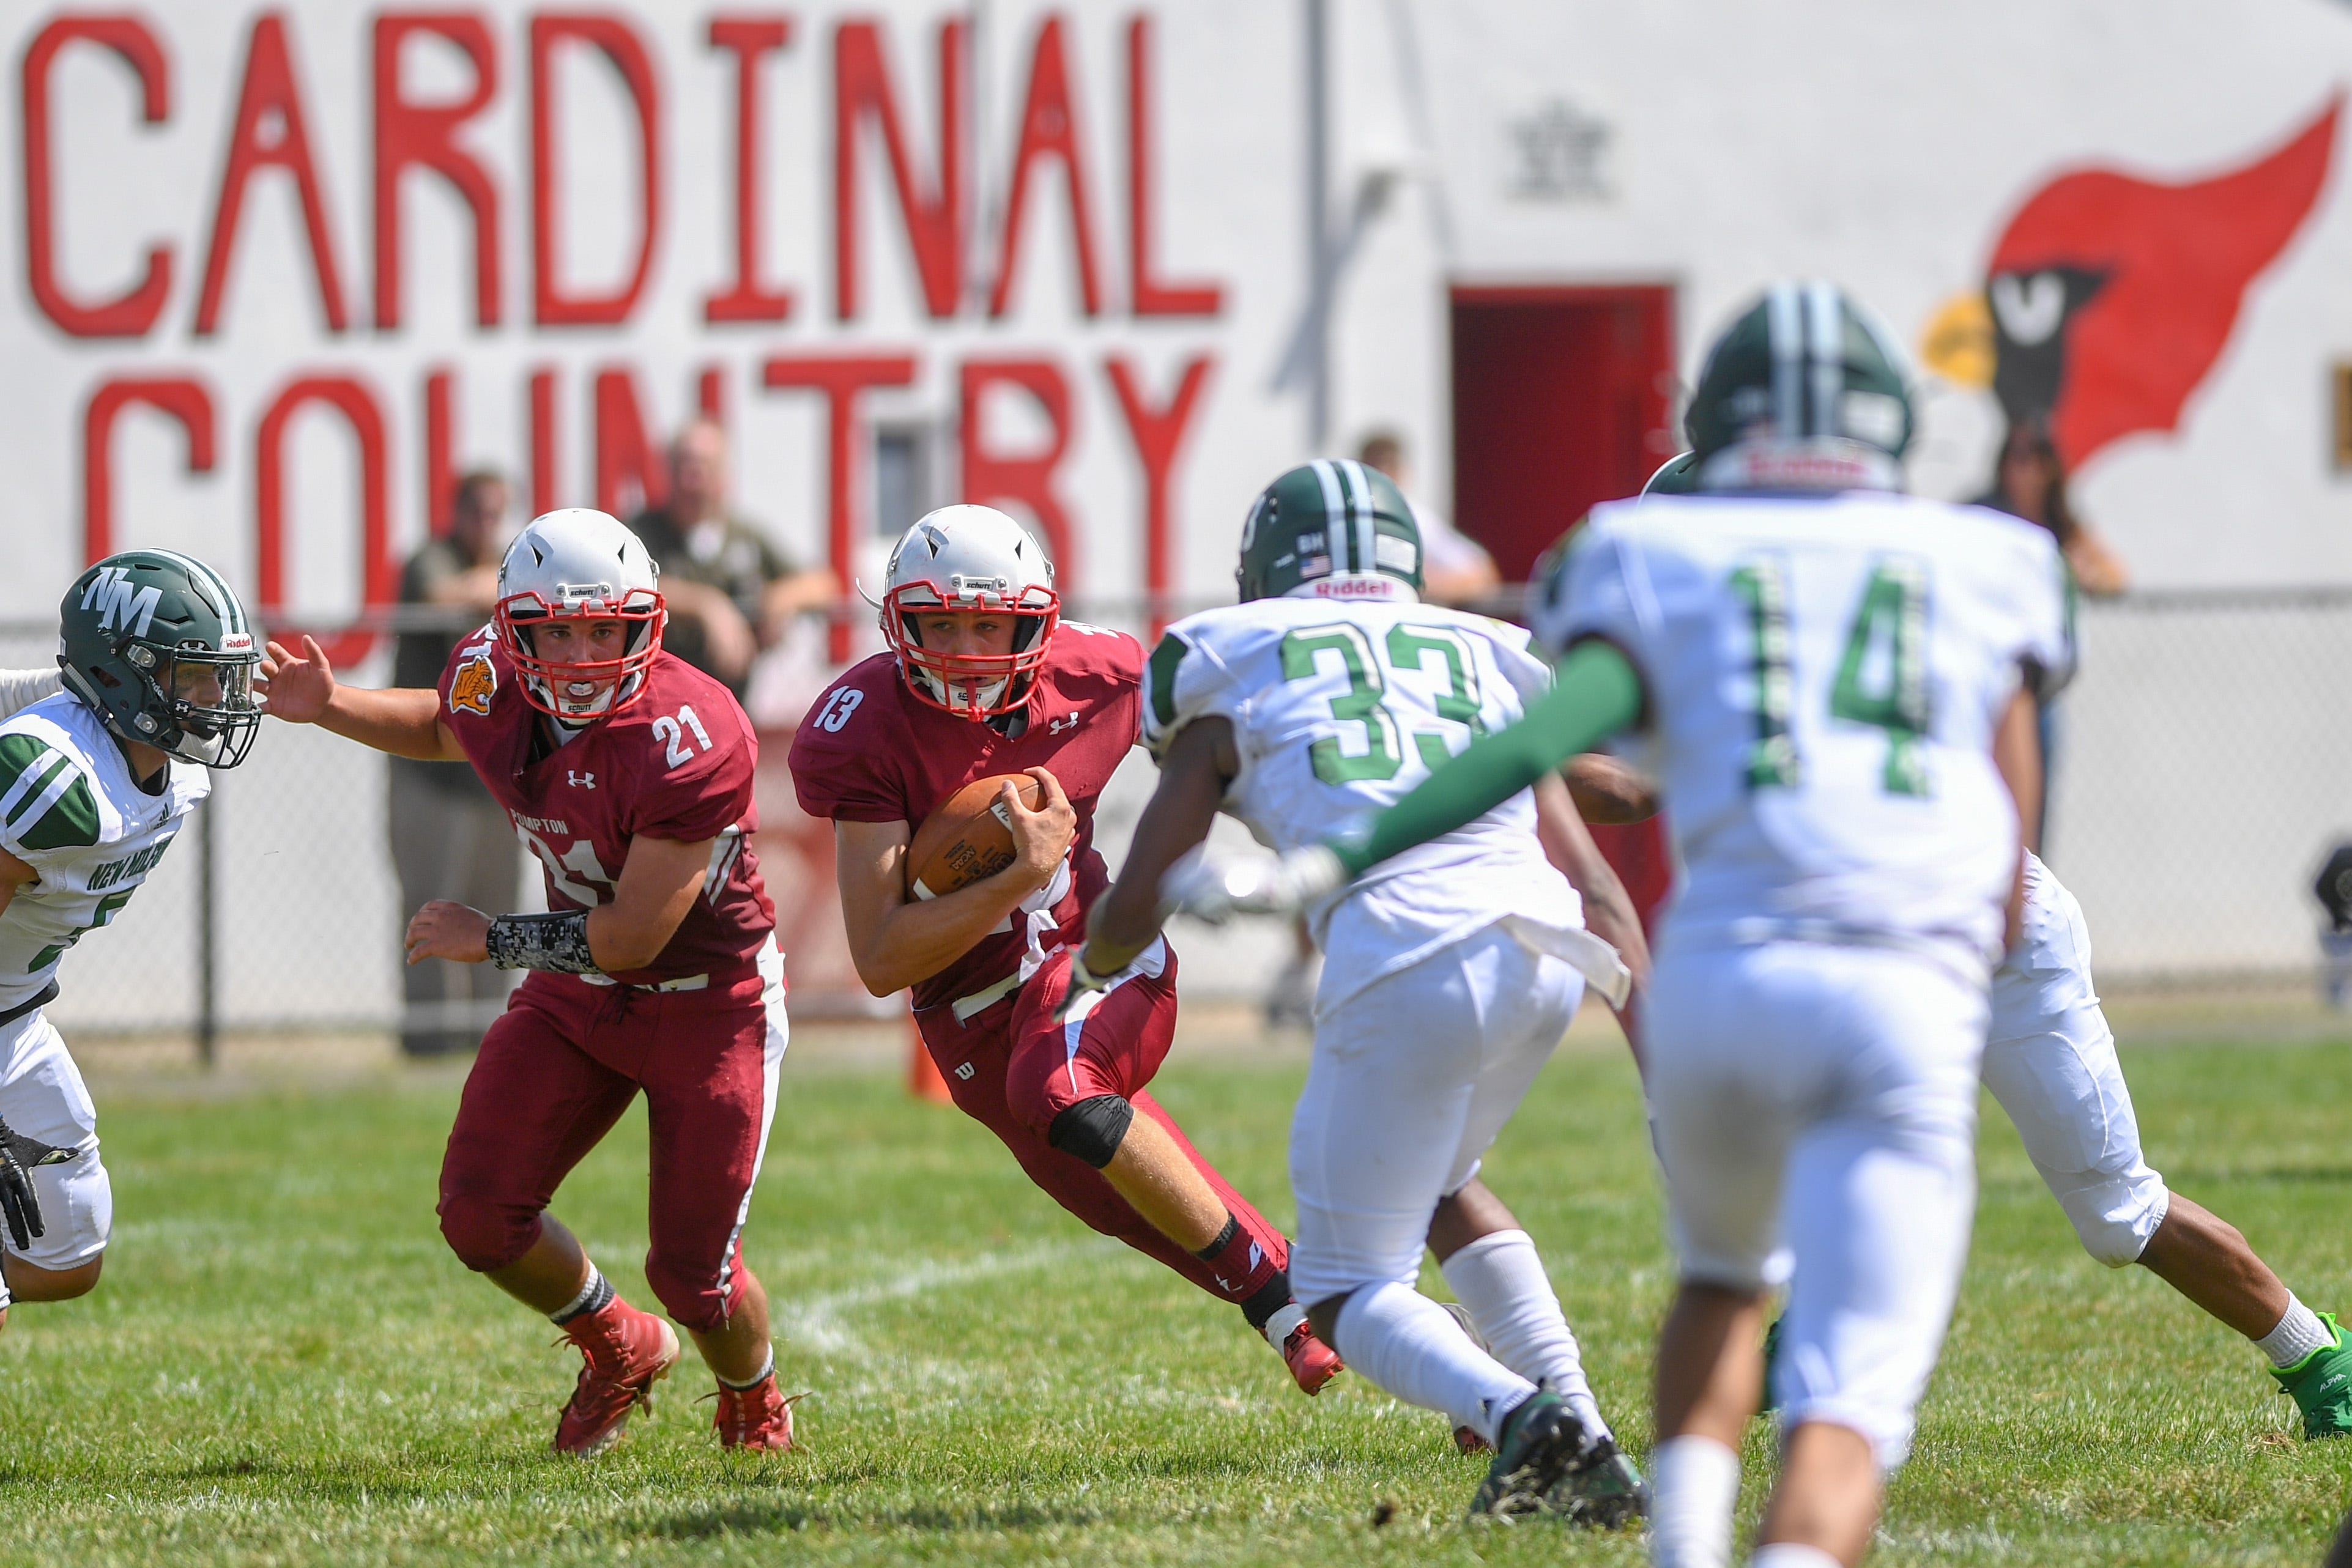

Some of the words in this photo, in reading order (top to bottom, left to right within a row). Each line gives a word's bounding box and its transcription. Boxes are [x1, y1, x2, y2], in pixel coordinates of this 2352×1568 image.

[23, 12, 1222, 336] CARDINAL
[81, 566, 163, 638] NM
[812, 685, 864, 733] 13
[1280, 621, 1490, 786] 33
[1727, 559, 1931, 797] 14
[651, 704, 713, 769] 21
[510, 807, 569, 835] POMPTON
[87, 856, 131, 891] NEW
[2319, 1373, 2347, 1394] ALPHA
